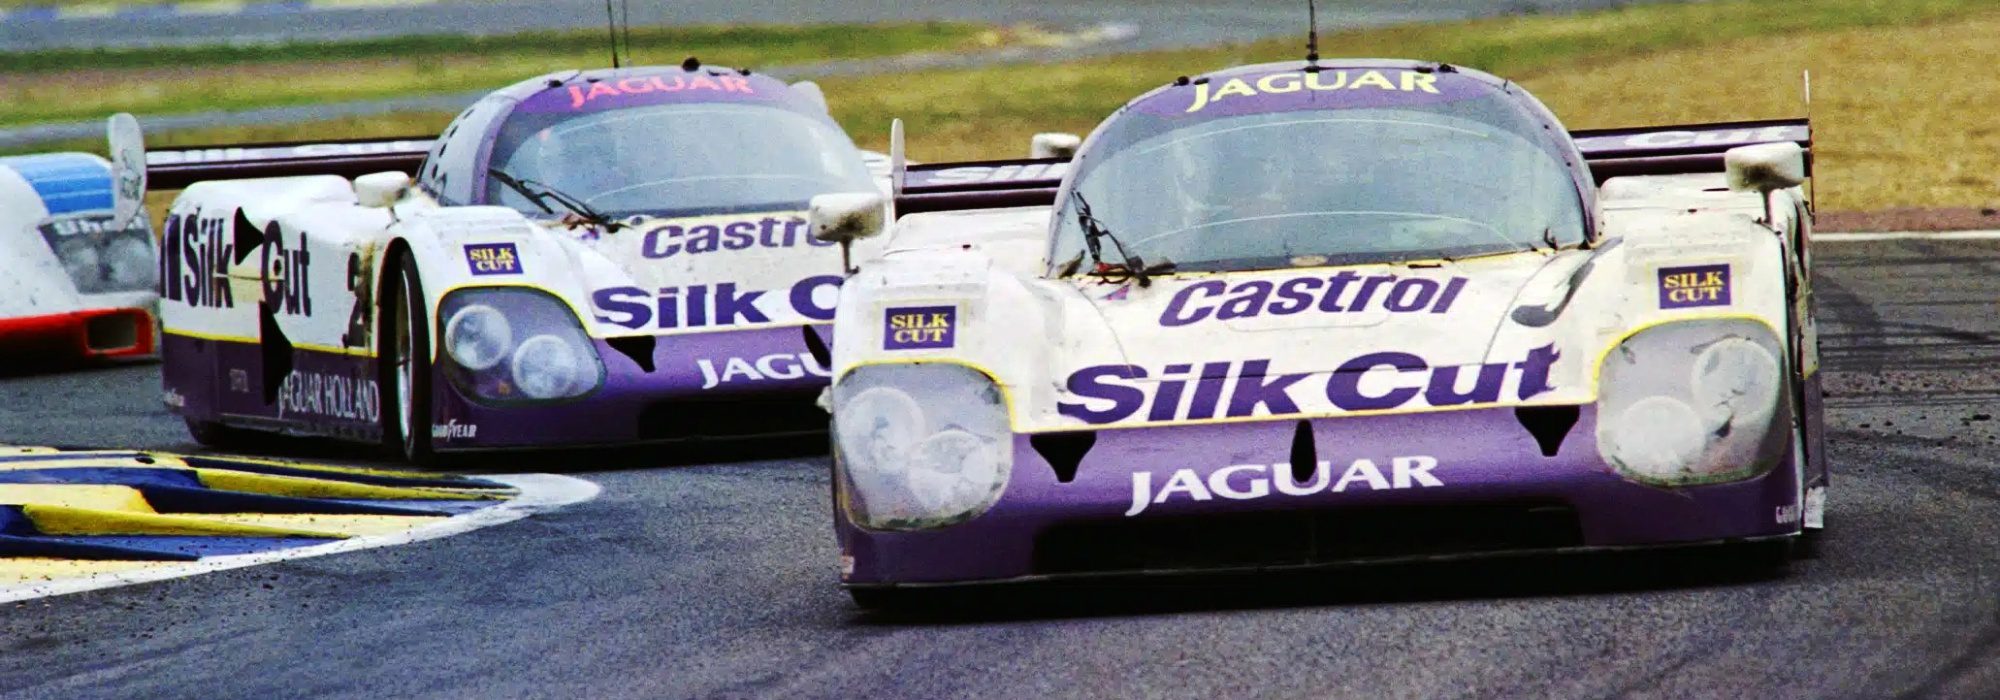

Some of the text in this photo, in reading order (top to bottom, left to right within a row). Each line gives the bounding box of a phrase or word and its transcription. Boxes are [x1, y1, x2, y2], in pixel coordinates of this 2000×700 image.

[568, 75, 754, 108] JAGUAR
[1185, 70, 1441, 113] JAGUAR
[183, 213, 313, 318] Silk Cut
[469, 247, 515, 261] SILK
[476, 259, 515, 272] CUT
[1158, 269, 1470, 328] Castrol
[1663, 270, 1725, 289] SILK
[1668, 286, 1723, 303] CUT
[591, 282, 773, 330] Silk
[890, 312, 950, 330] SILK
[893, 328, 948, 344] CUT
[324, 374, 380, 424] HOLLAND
[1057, 341, 1562, 425] Silk Cut
[1124, 454, 1444, 517] JAGUAR
